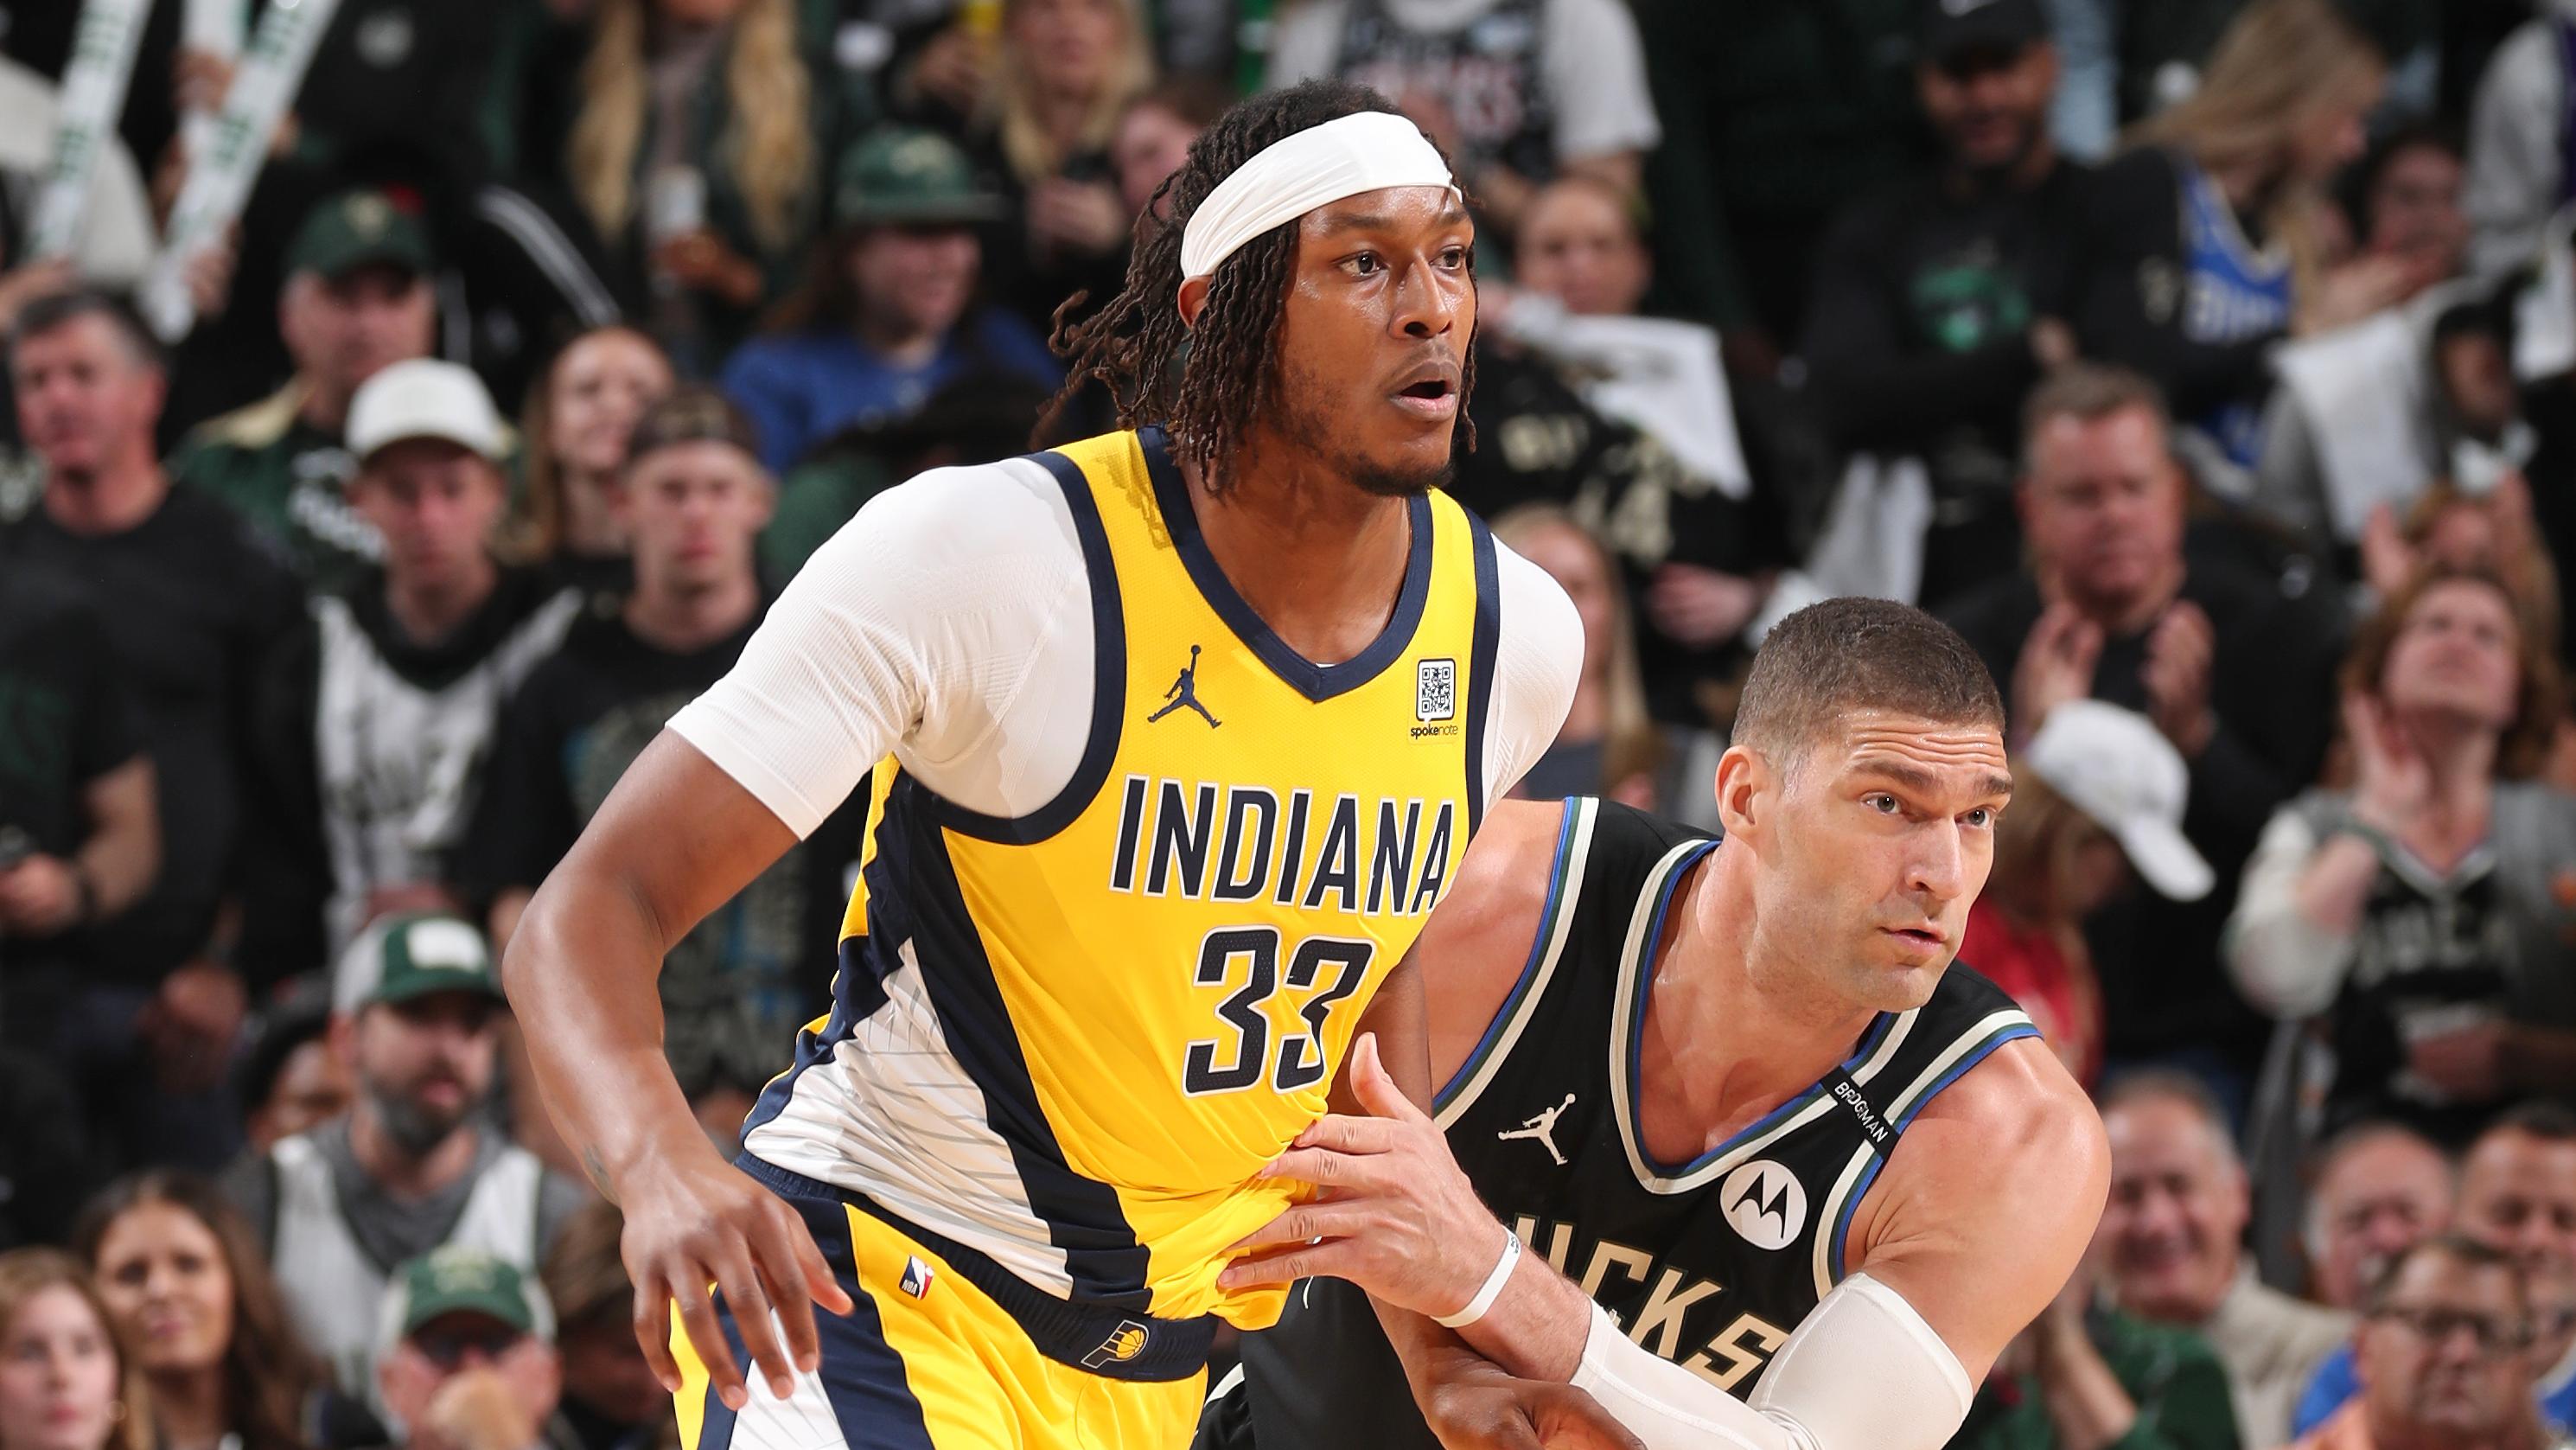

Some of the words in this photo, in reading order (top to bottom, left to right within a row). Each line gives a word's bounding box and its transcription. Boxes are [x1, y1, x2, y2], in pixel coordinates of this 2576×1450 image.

[1411, 724, 1458, 739] spokenote
[1109, 774, 1455, 918] INDIANA
[1182, 924, 1377, 1098] 33
